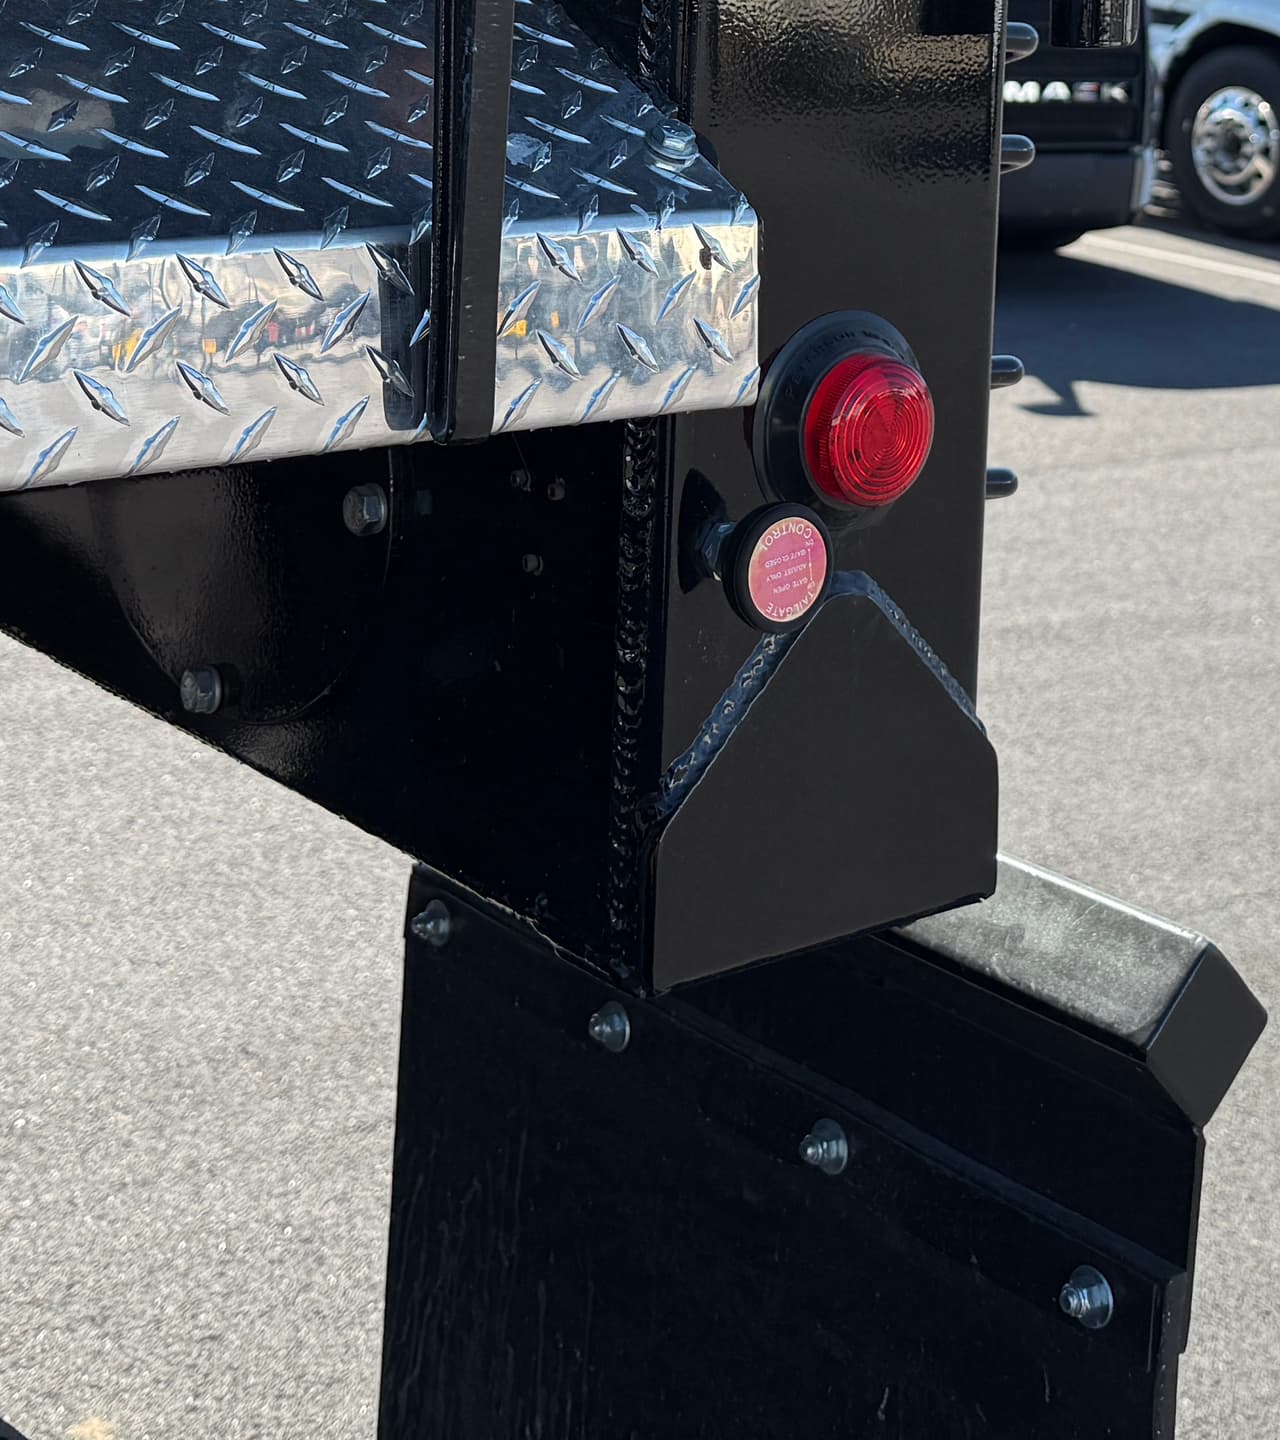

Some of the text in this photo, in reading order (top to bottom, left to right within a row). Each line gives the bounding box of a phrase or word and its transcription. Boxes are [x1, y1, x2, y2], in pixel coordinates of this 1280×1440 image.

[1003, 80, 1128, 103] MACK
[759, 523, 812, 552] CONTROL
[764, 549, 807, 569] GATE CLOSED
[767, 563, 807, 582] ADJUST ONLY
[773, 576, 809, 594] GATE OPEN
[766, 591, 814, 617] TAILGATE
